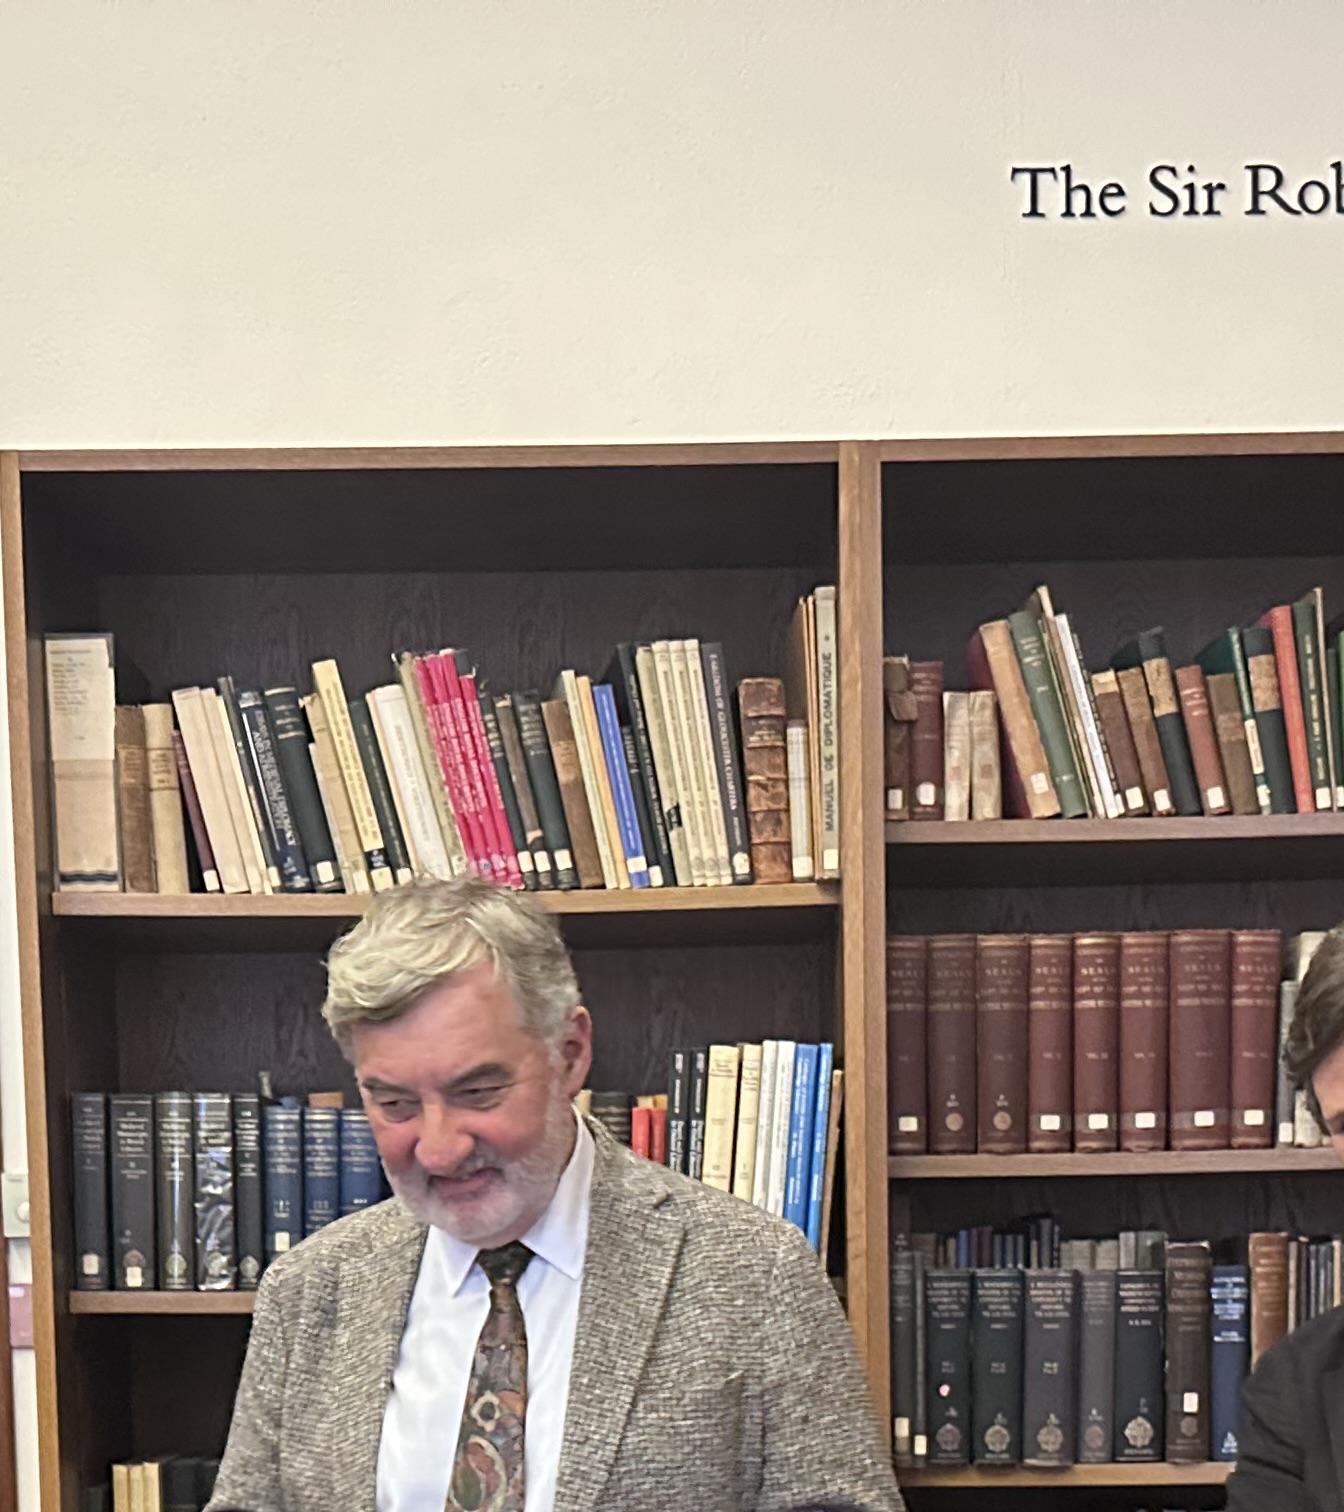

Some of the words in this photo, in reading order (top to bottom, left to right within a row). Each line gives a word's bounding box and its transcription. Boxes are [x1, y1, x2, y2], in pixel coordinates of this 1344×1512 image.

[1009, 163, 1127, 218] The
[1148, 163, 1227, 218] Sir
[821, 652, 834, 747] DIPLOMATIQUE
[824, 753, 835, 772] DE
[823, 779, 836, 832] MANUEL
